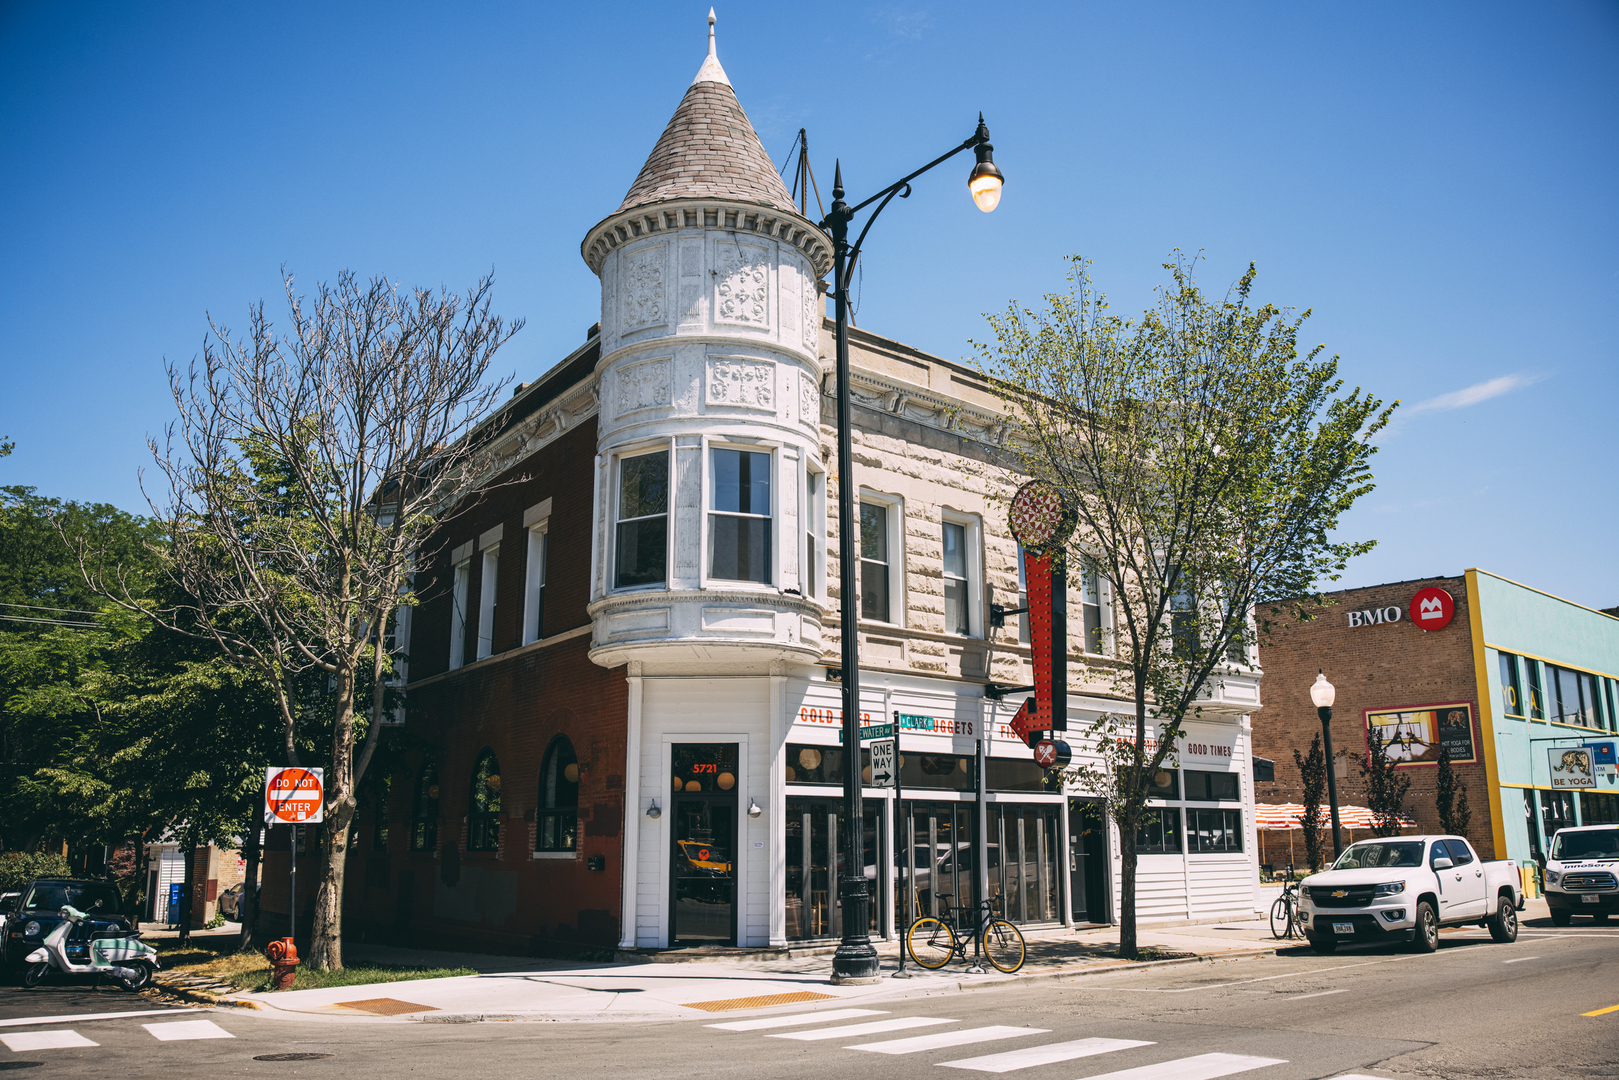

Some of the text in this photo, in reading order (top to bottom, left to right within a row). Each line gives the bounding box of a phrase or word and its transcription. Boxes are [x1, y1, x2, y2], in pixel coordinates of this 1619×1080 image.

[1346, 606, 1402, 629] BMO
[800, 707, 834, 724] COLD
[906, 716, 928, 728] CLARK
[859, 727, 885, 739] EWATER
[925, 718, 973, 735] UGGETS
[1000, 725, 1020, 739] FIS
[873, 744, 892, 757] ONE
[1188, 742, 1208, 755] GOOD
[1210, 744, 1231, 757] TIMES
[693, 763, 717, 774] 5721
[873, 756, 893, 770] WAY
[276, 778, 314, 788] DO NOT
[1553, 777, 1594, 786] BE YOGA
[279, 802, 311, 812] ENTER
